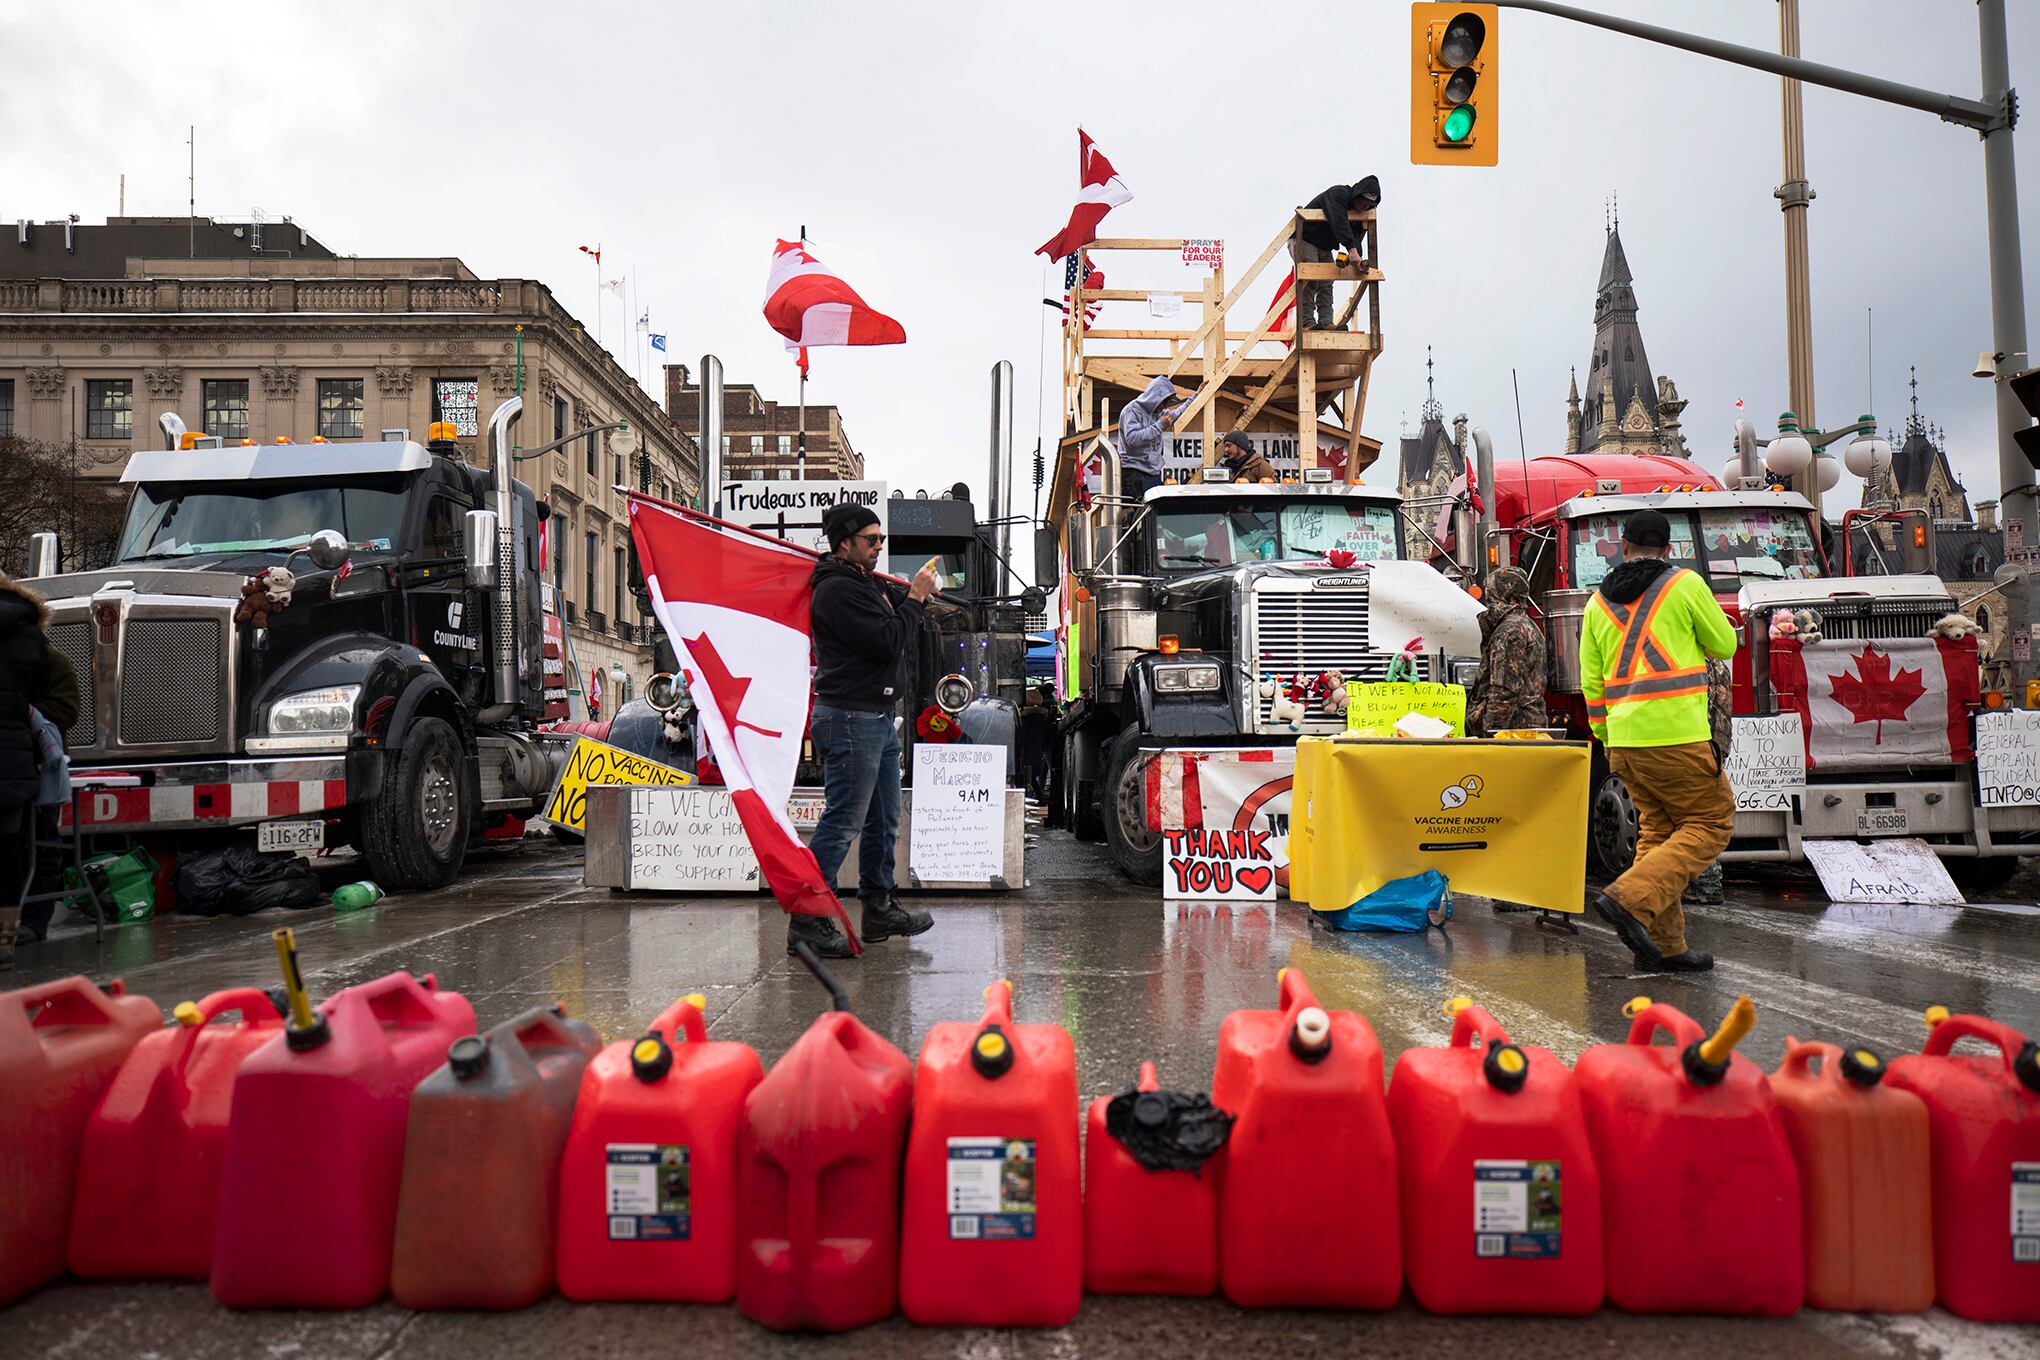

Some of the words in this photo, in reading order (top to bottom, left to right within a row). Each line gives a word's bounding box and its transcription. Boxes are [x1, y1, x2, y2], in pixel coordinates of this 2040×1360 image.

[1182, 254, 1222, 262] LEADERS
[1173, 439, 1202, 458] KEE
[722, 483, 805, 511] Trudeau's
[810, 491, 835, 507] new
[839, 487, 878, 507] home
[1346, 531, 1380, 540] FAITH
[1350, 542, 1379, 550] OVER
[1357, 551, 1378, 560] EAR
[1319, 578, 1367, 587] FREIGHTLINER
[1348, 682, 1363, 698] IF
[1369, 685, 1405, 697] WE'RE
[1414, 686, 1431, 696] NOT
[1368, 703, 1398, 712] BLOW
[1407, 702, 1427, 711] THE
[1737, 719, 1800, 737] GOVERNOR
[1754, 738, 1775, 753] TO
[1978, 734, 2036, 752] GENERAL
[566, 745, 605, 782] NO
[1756, 754, 1801, 769] ABOUT
[958, 788, 990, 803] 9AM
[631, 789, 655, 815] IF
[671, 791, 701, 818] WE
[632, 819, 679, 837] BLOW
[688, 822, 713, 836] OUR
[1858, 816, 1870, 829] BL
[1876, 815, 1906, 828] 66988
[270, 830, 291, 844] 116
[299, 829, 320, 842] 2FW
[1426, 826, 1486, 834] AWARENESS
[632, 844, 682, 858] BRING
[1164, 829, 1273, 861] THANK
[633, 863, 663, 879] FOR
[1168, 857, 1233, 894] YOU
